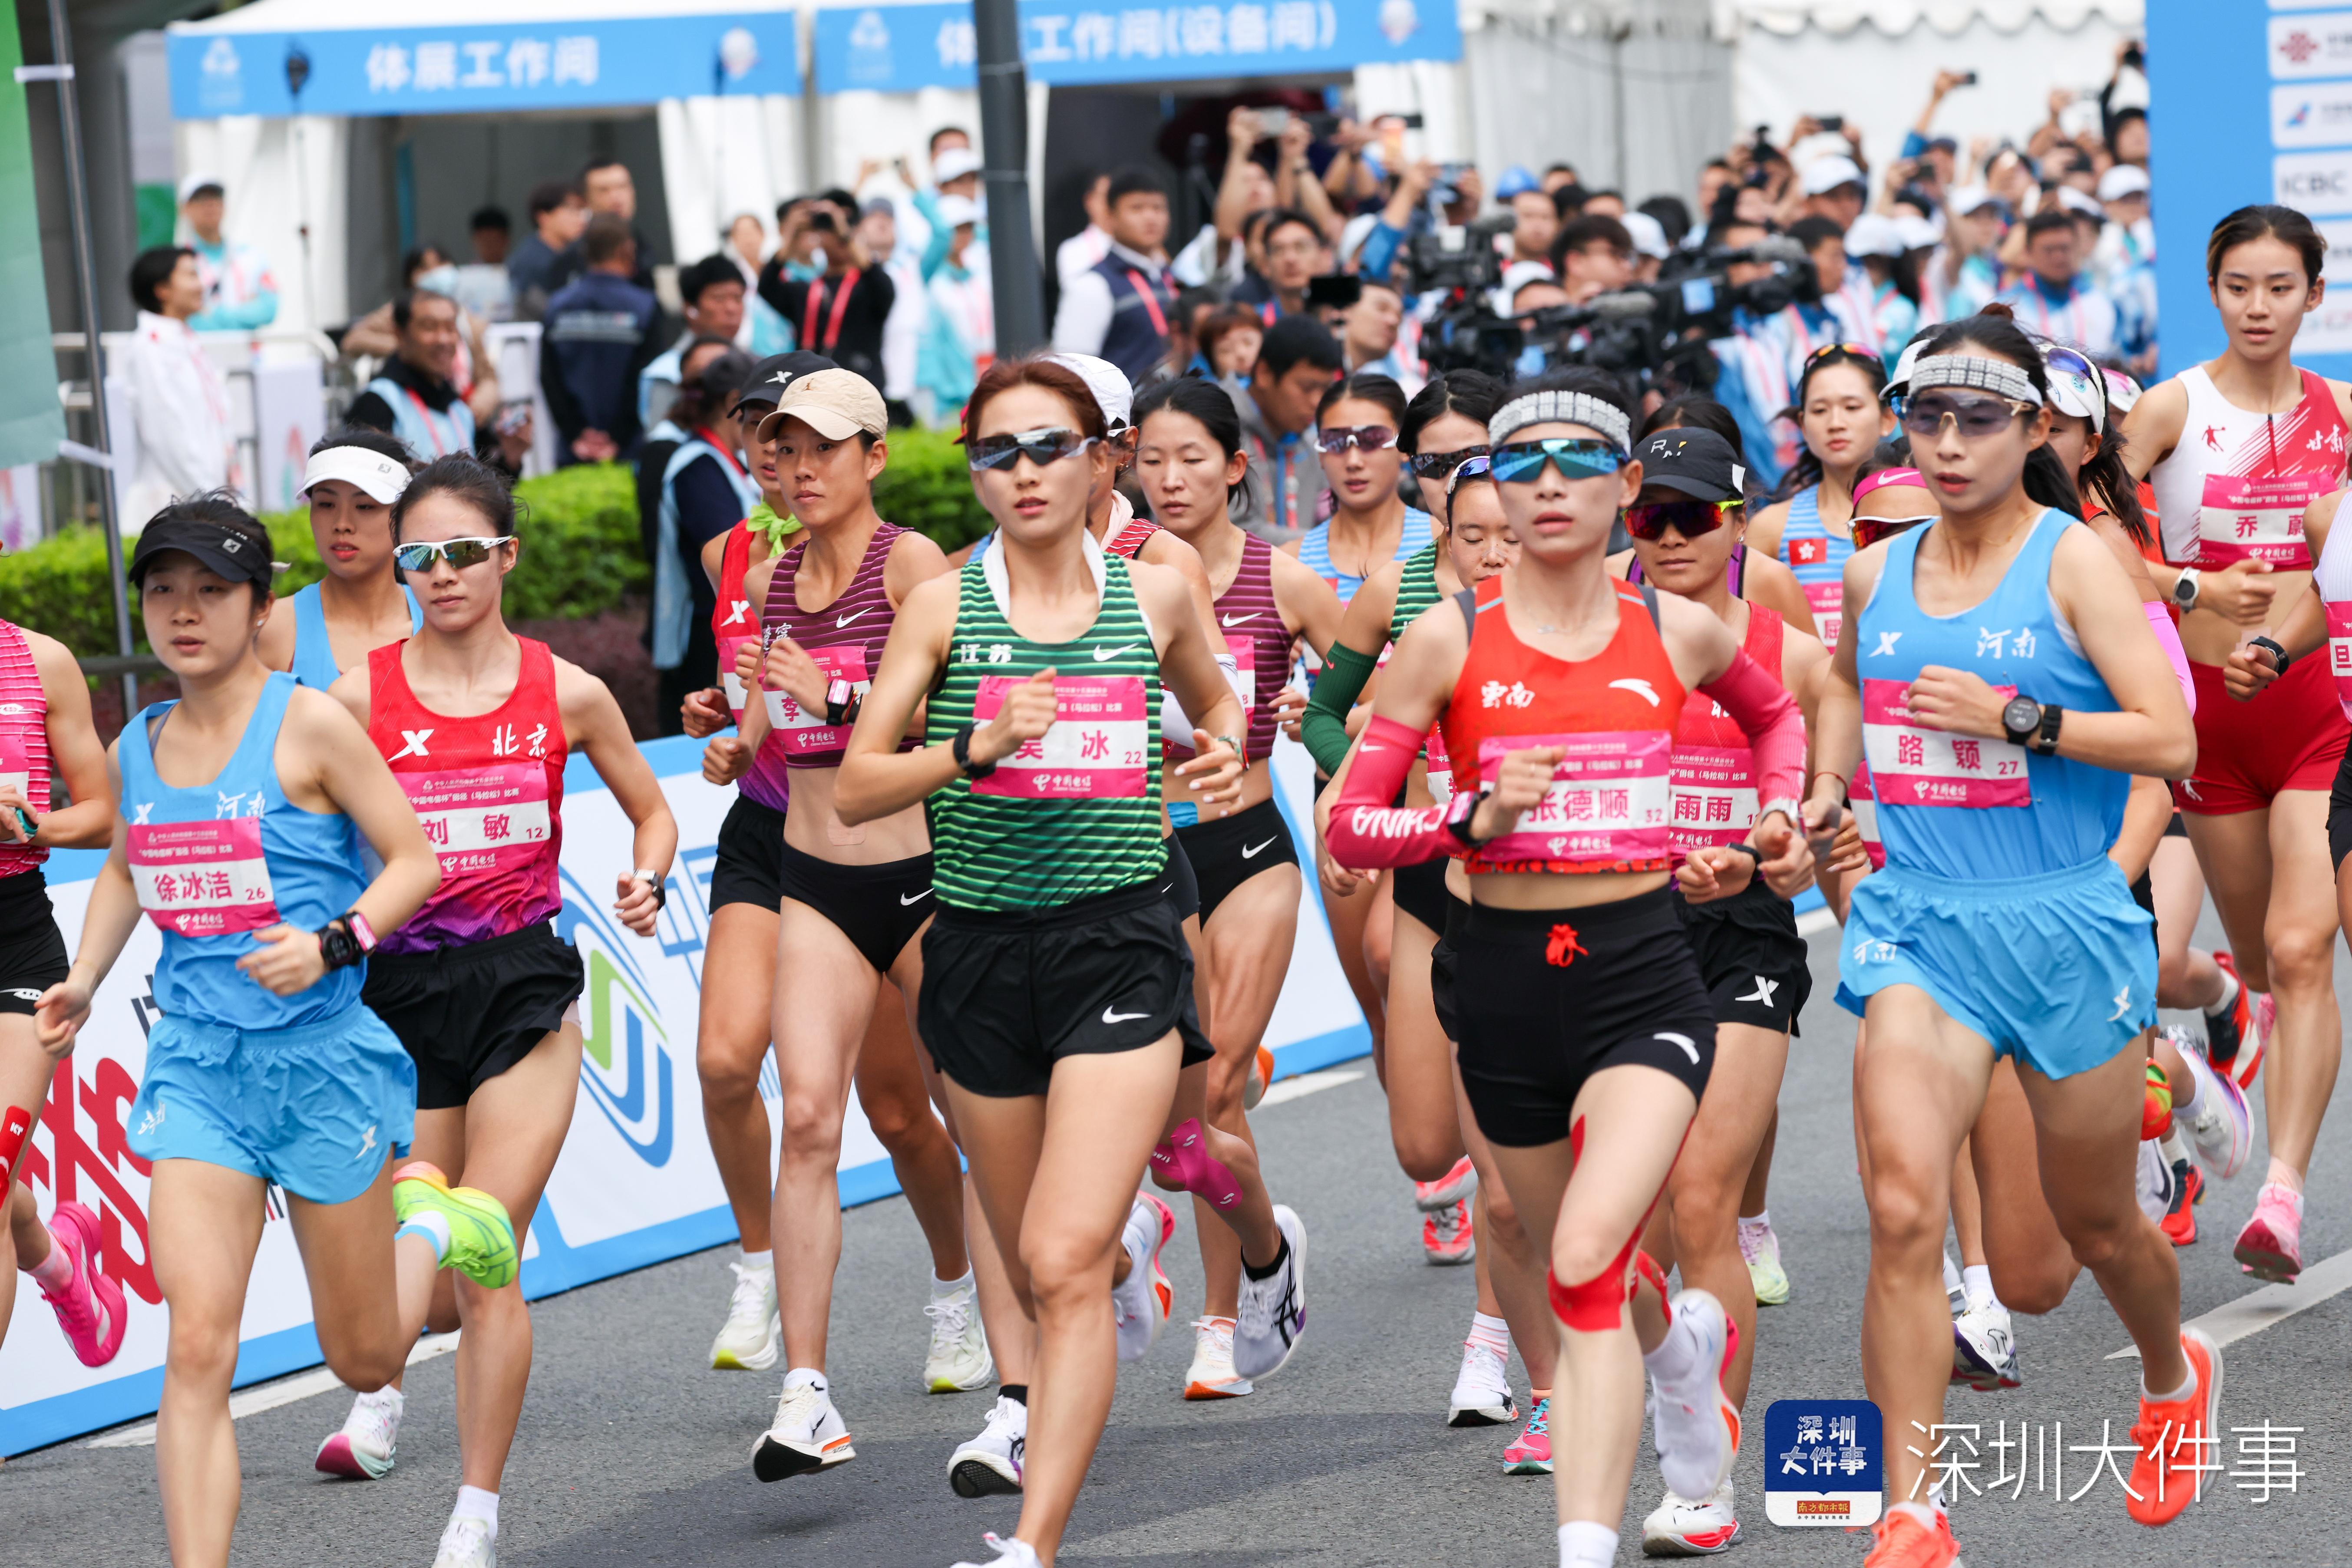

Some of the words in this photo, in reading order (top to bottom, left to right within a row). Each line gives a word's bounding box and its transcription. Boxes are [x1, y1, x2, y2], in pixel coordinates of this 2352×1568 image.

[936, 1, 1337, 65] 体工作间(设备间)
[960, 643, 1013, 664] 江苏
[1976, 627, 2037, 659] 河南
[781, 696, 799, 722] 李
[492, 722, 548, 757] 北京
[1124, 751, 1142, 765] 22
[1998, 761, 2018, 776] 27
[525, 826, 543, 839] 12
[1352, 804, 1449, 838] CHINA
[154, 871, 233, 902] 徐冰洁
[245, 887, 265, 901] 26
